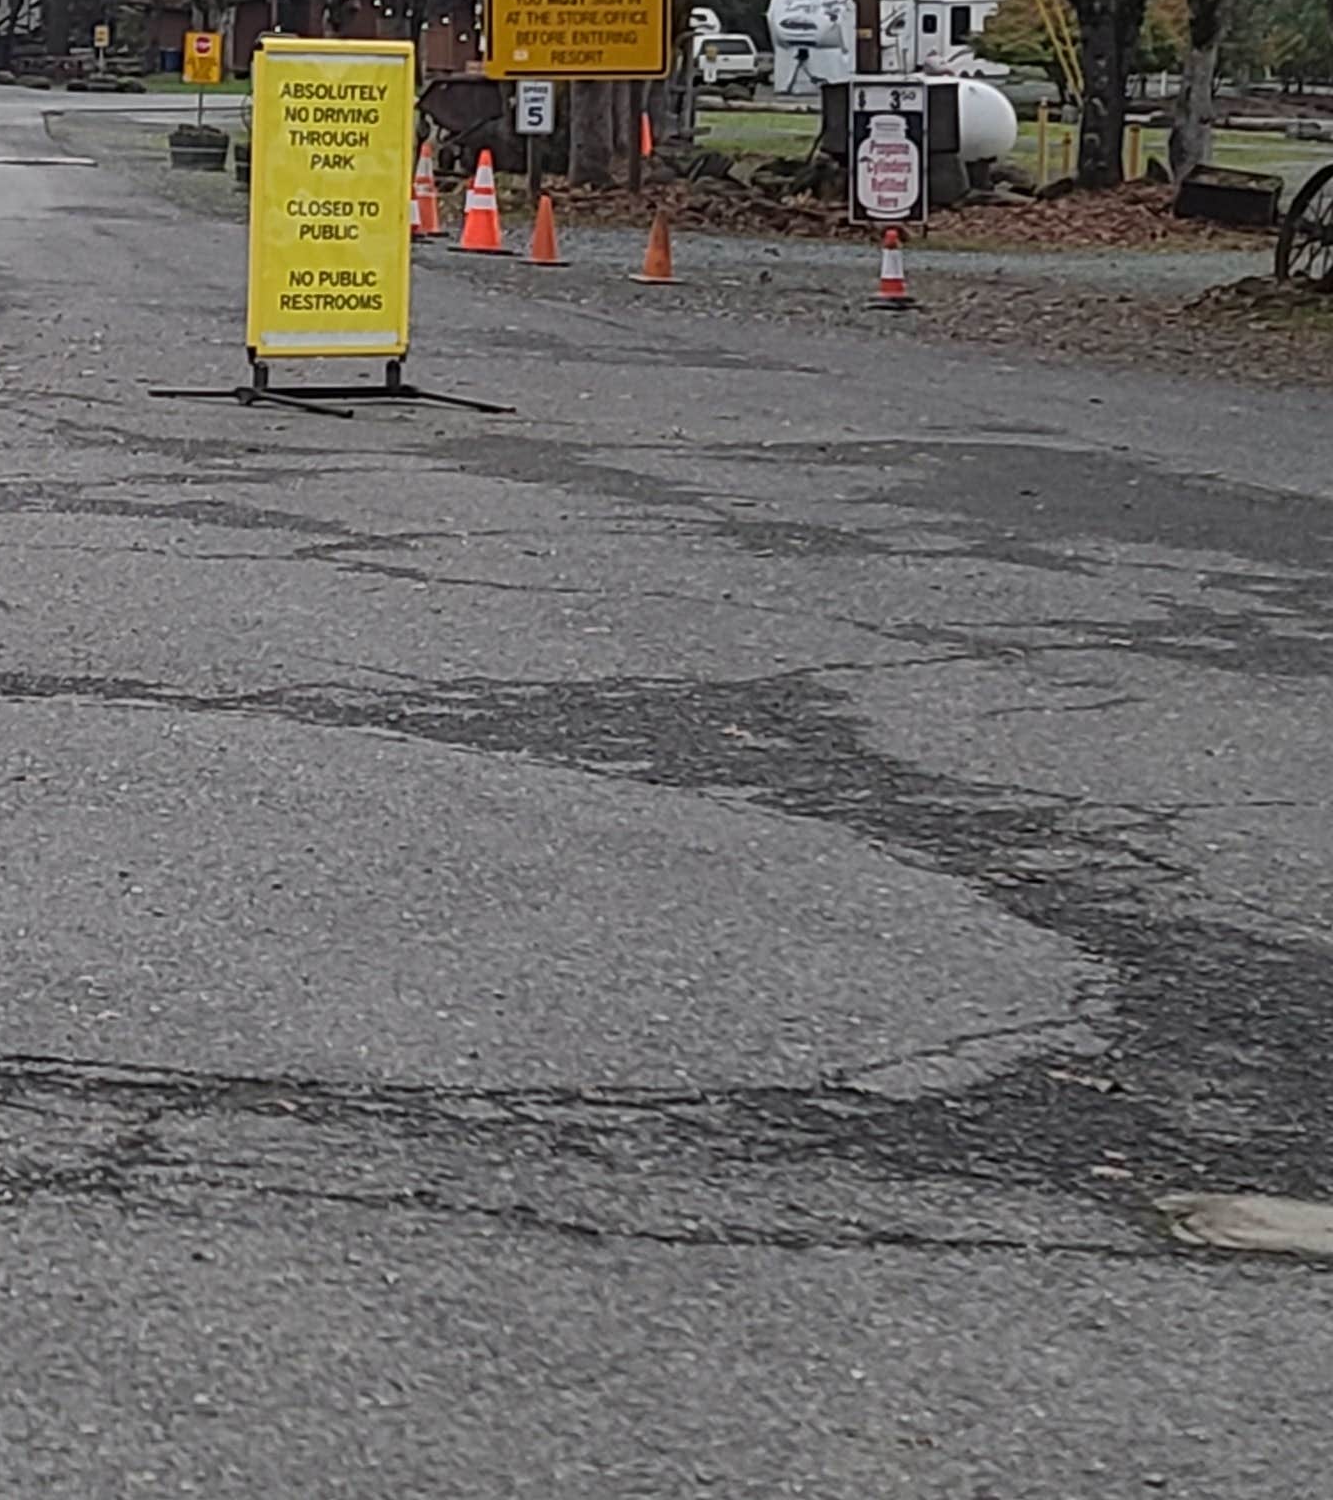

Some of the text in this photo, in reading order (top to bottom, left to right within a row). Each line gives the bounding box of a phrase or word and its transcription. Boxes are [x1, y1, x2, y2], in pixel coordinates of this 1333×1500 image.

[506, 11, 520, 25] AT
[527, 11, 550, 25] THE
[516, 31, 637, 45] BEFORE ENTERING
[551, 50, 603, 64] RESORT
[280, 82, 387, 101] ABSOLUTELY
[285, 106, 379, 124] NO DRIVING
[527, 106, 544, 126] 5
[289, 130, 369, 147] THROUGH
[310, 153, 354, 170] PARK
[286, 200, 379, 217] CLOSED TO
[299, 224, 359, 240] PUBLIC
[289, 270, 377, 287] NO PUBLIC
[279, 294, 383, 311] RESTROOMS
